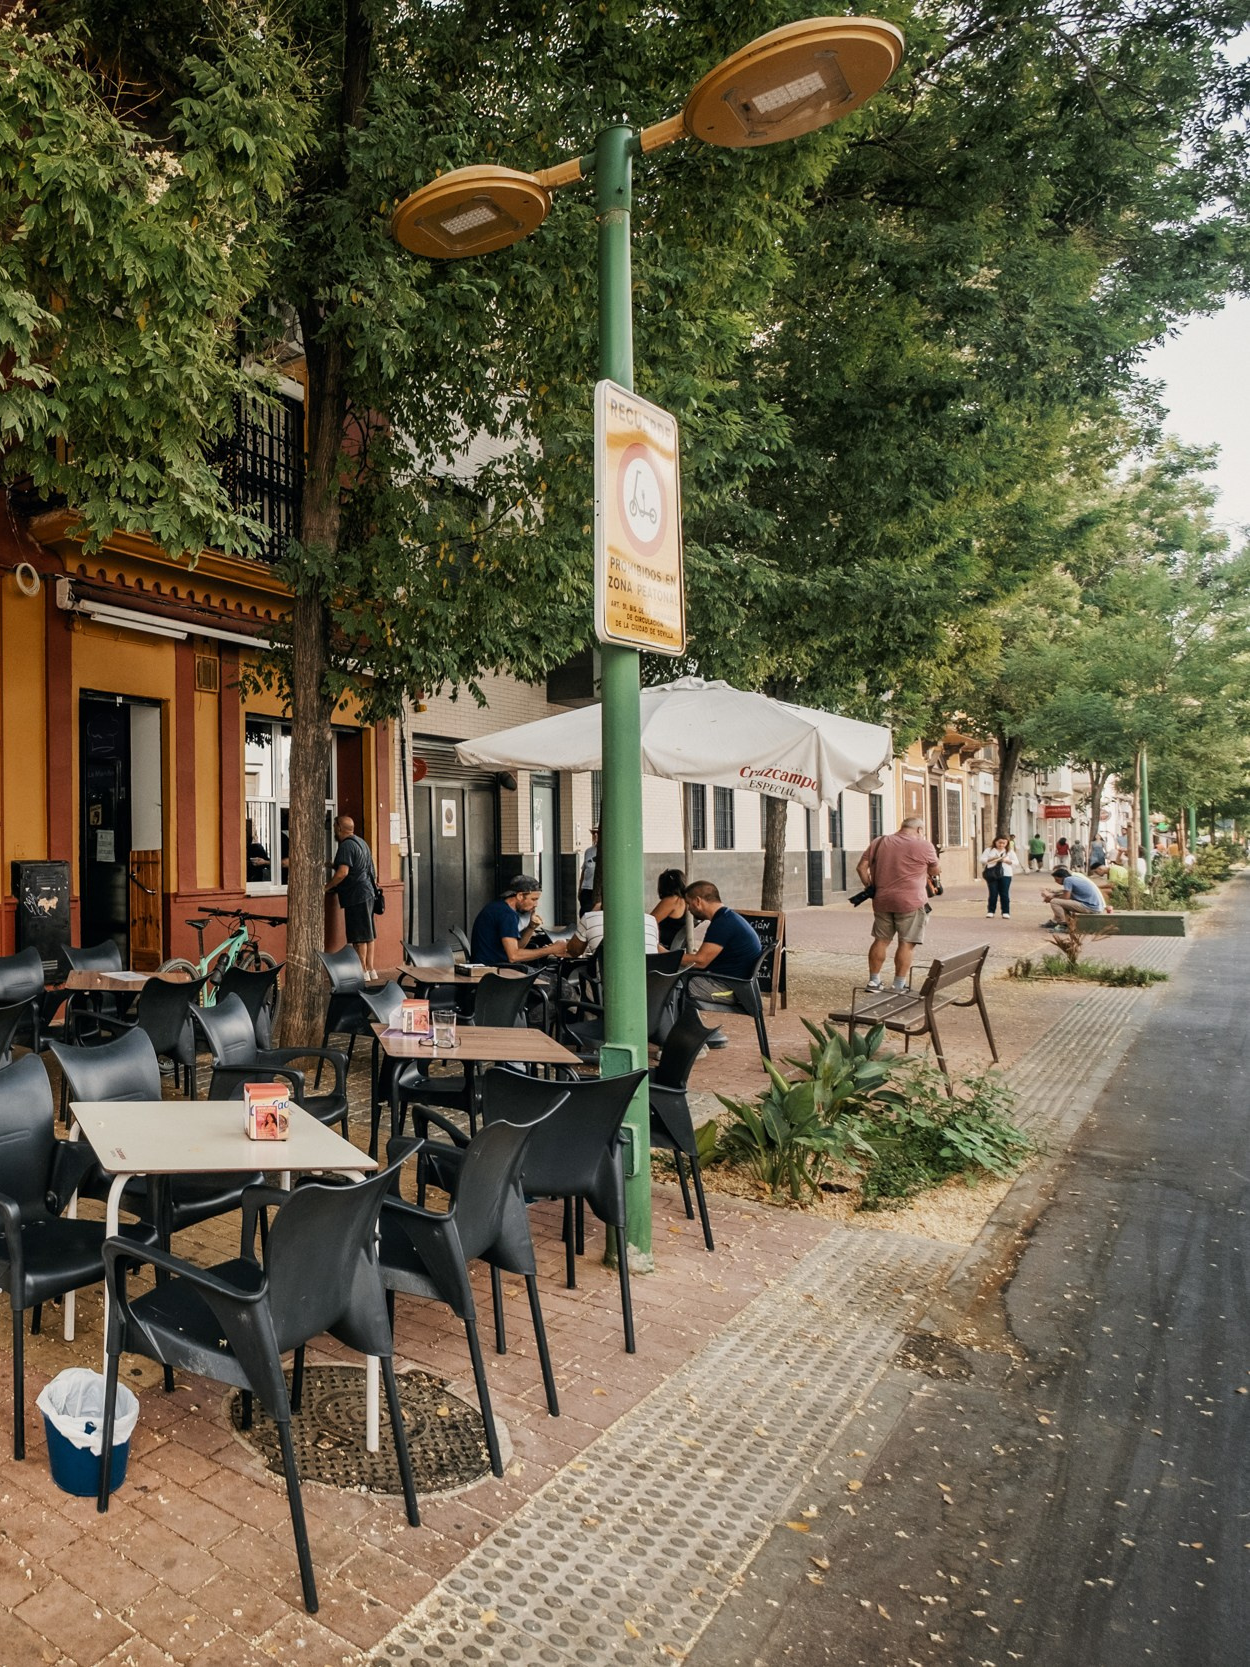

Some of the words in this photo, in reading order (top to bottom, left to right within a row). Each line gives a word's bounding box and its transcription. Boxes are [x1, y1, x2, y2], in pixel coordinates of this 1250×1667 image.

[610, 556, 662, 583] PROHIBIDOS
[665, 574, 676, 586] EN
[608, 575, 633, 594] ZONA
[739, 765, 819, 791] Cruzcampo
[749, 779, 796, 798] ESPECIAL
